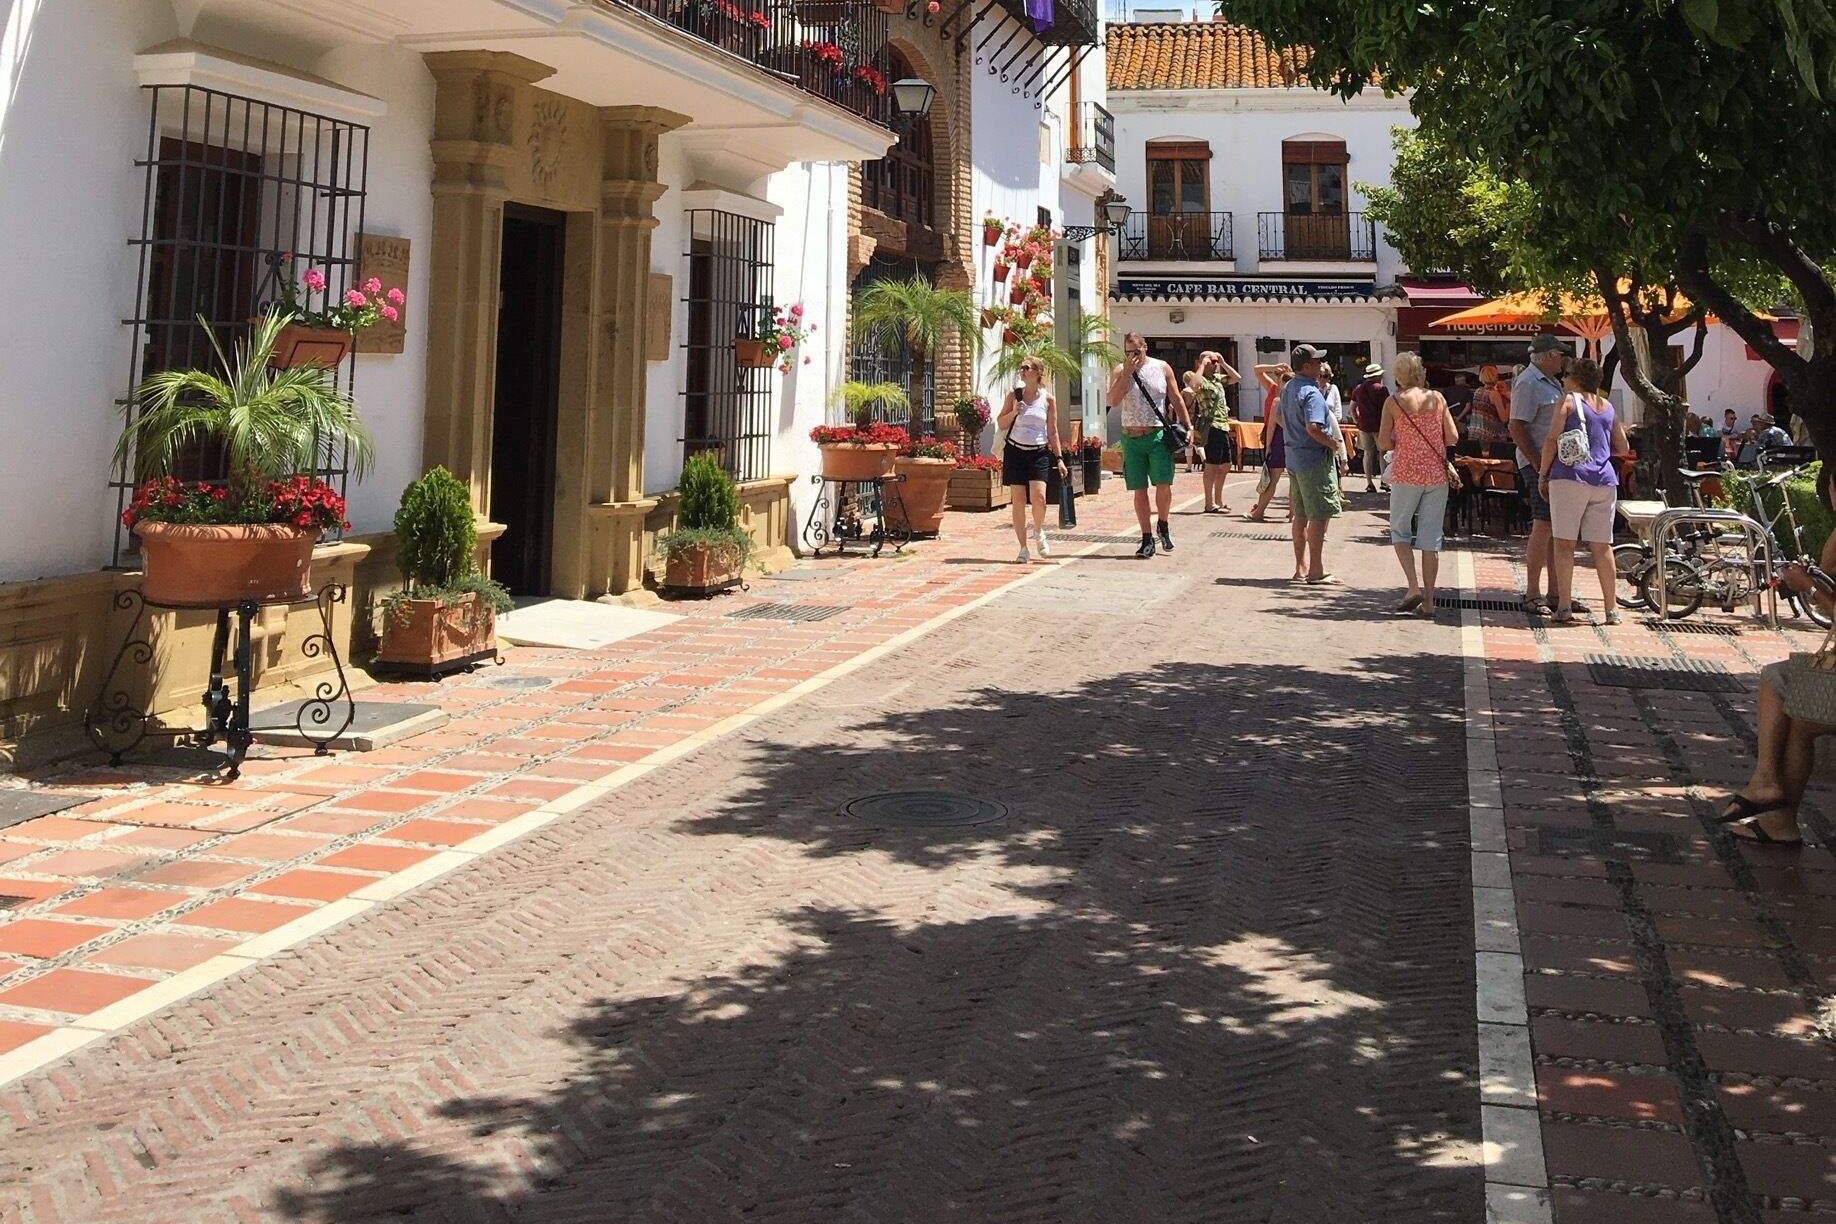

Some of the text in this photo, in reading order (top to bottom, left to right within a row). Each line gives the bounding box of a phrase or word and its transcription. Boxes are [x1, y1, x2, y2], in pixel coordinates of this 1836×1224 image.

[1167, 283, 1203, 294] CAFE
[1207, 284, 1237, 294] BAR
[1242, 284, 1308, 295] CENTRAL
